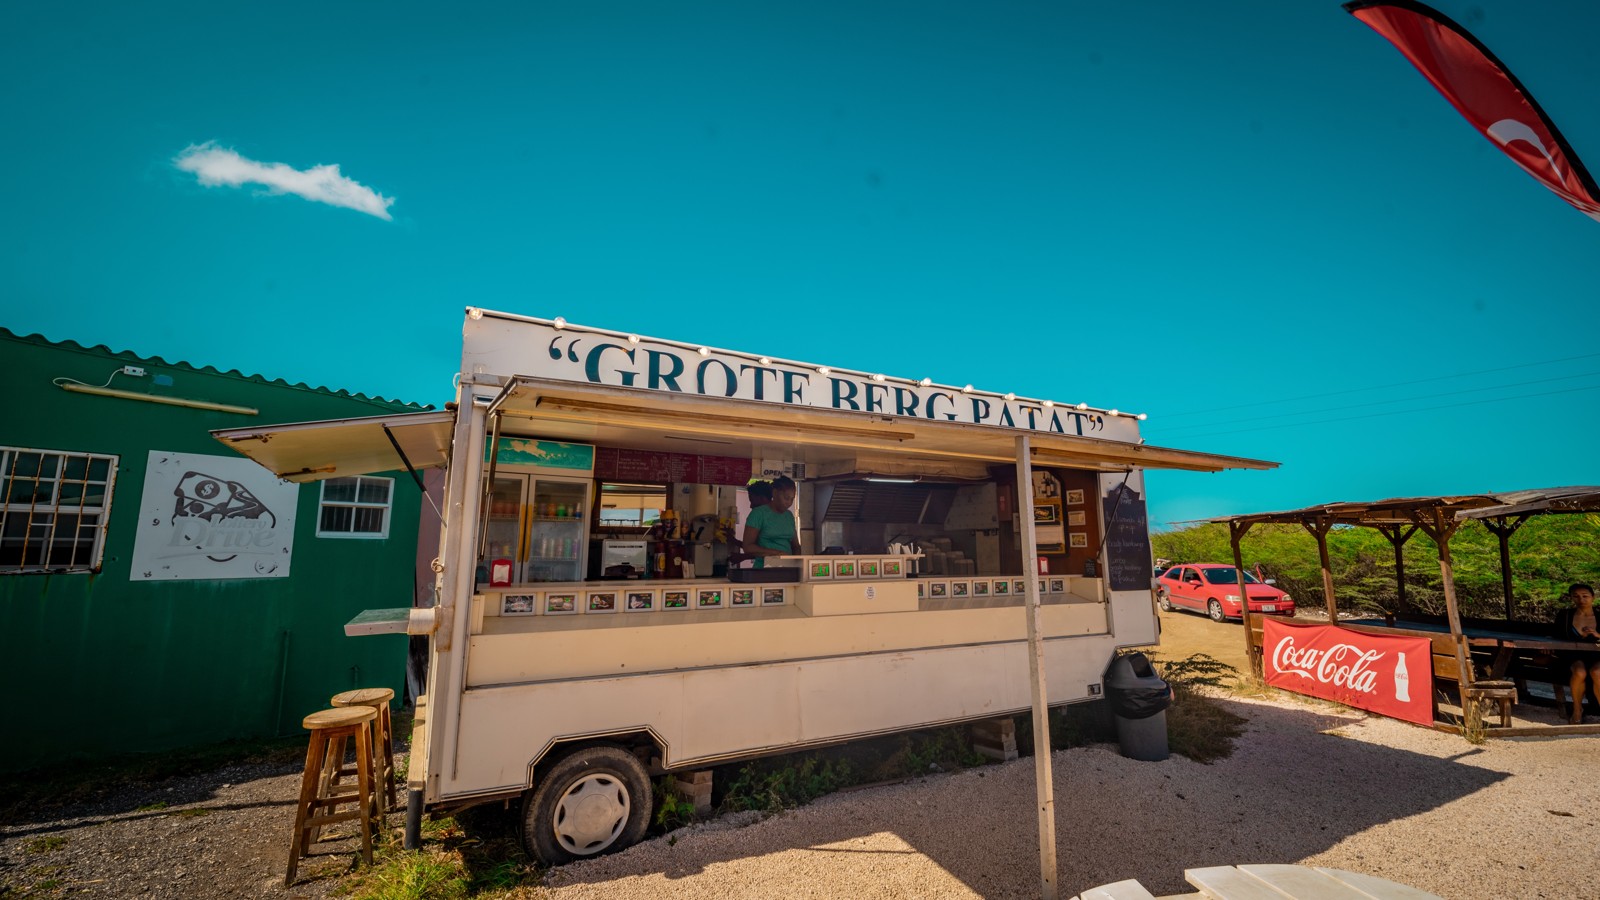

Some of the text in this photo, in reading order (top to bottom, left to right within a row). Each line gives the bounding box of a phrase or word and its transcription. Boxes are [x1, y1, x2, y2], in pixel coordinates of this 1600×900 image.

[827, 376, 958, 420] BERG
[763, 469, 783, 477] OPEN
[167, 519, 276, 547] Drive
[1272, 635, 1386, 693] Coca-Cola
